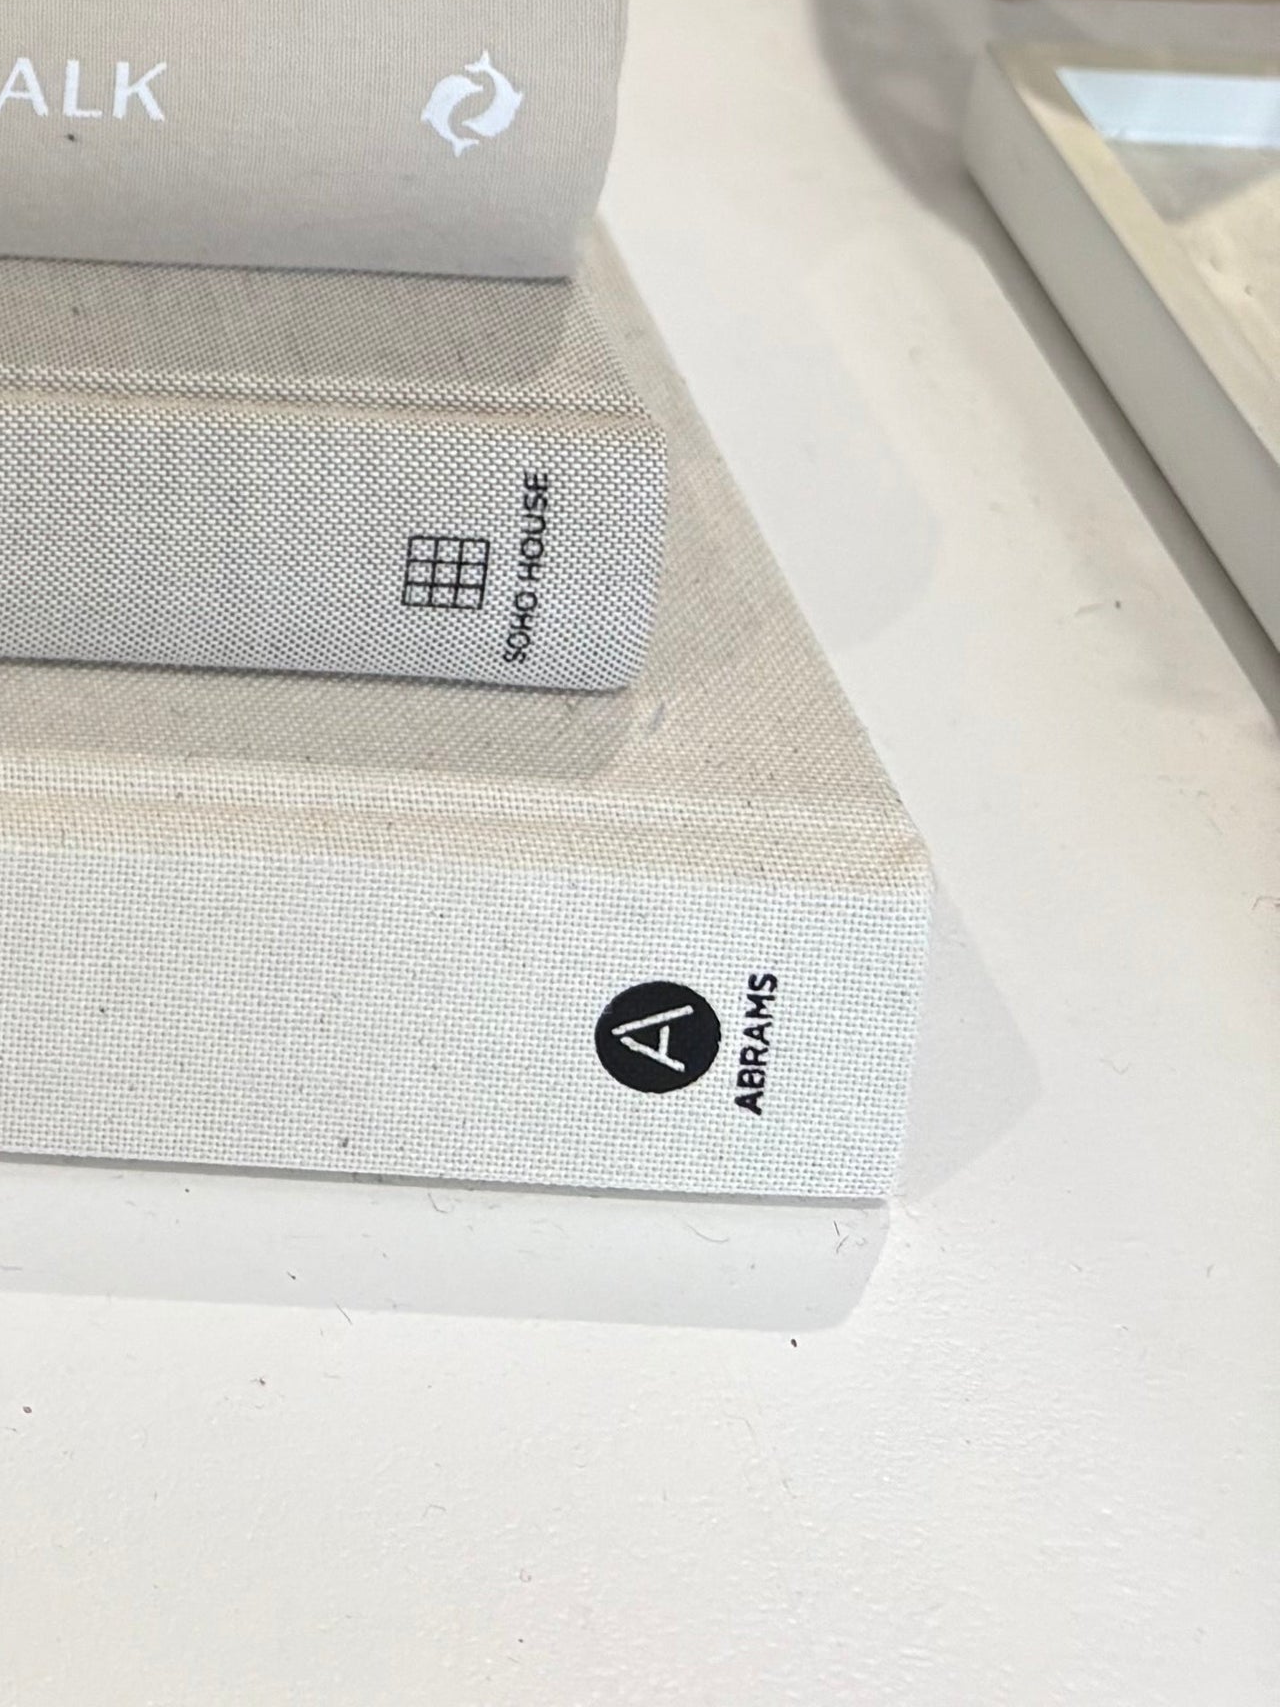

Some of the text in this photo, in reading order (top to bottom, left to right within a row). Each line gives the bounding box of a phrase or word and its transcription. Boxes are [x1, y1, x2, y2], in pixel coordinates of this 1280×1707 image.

[502, 471, 548, 664] SOHO HOUSE
[734, 972, 778, 1116] ABRAMS
